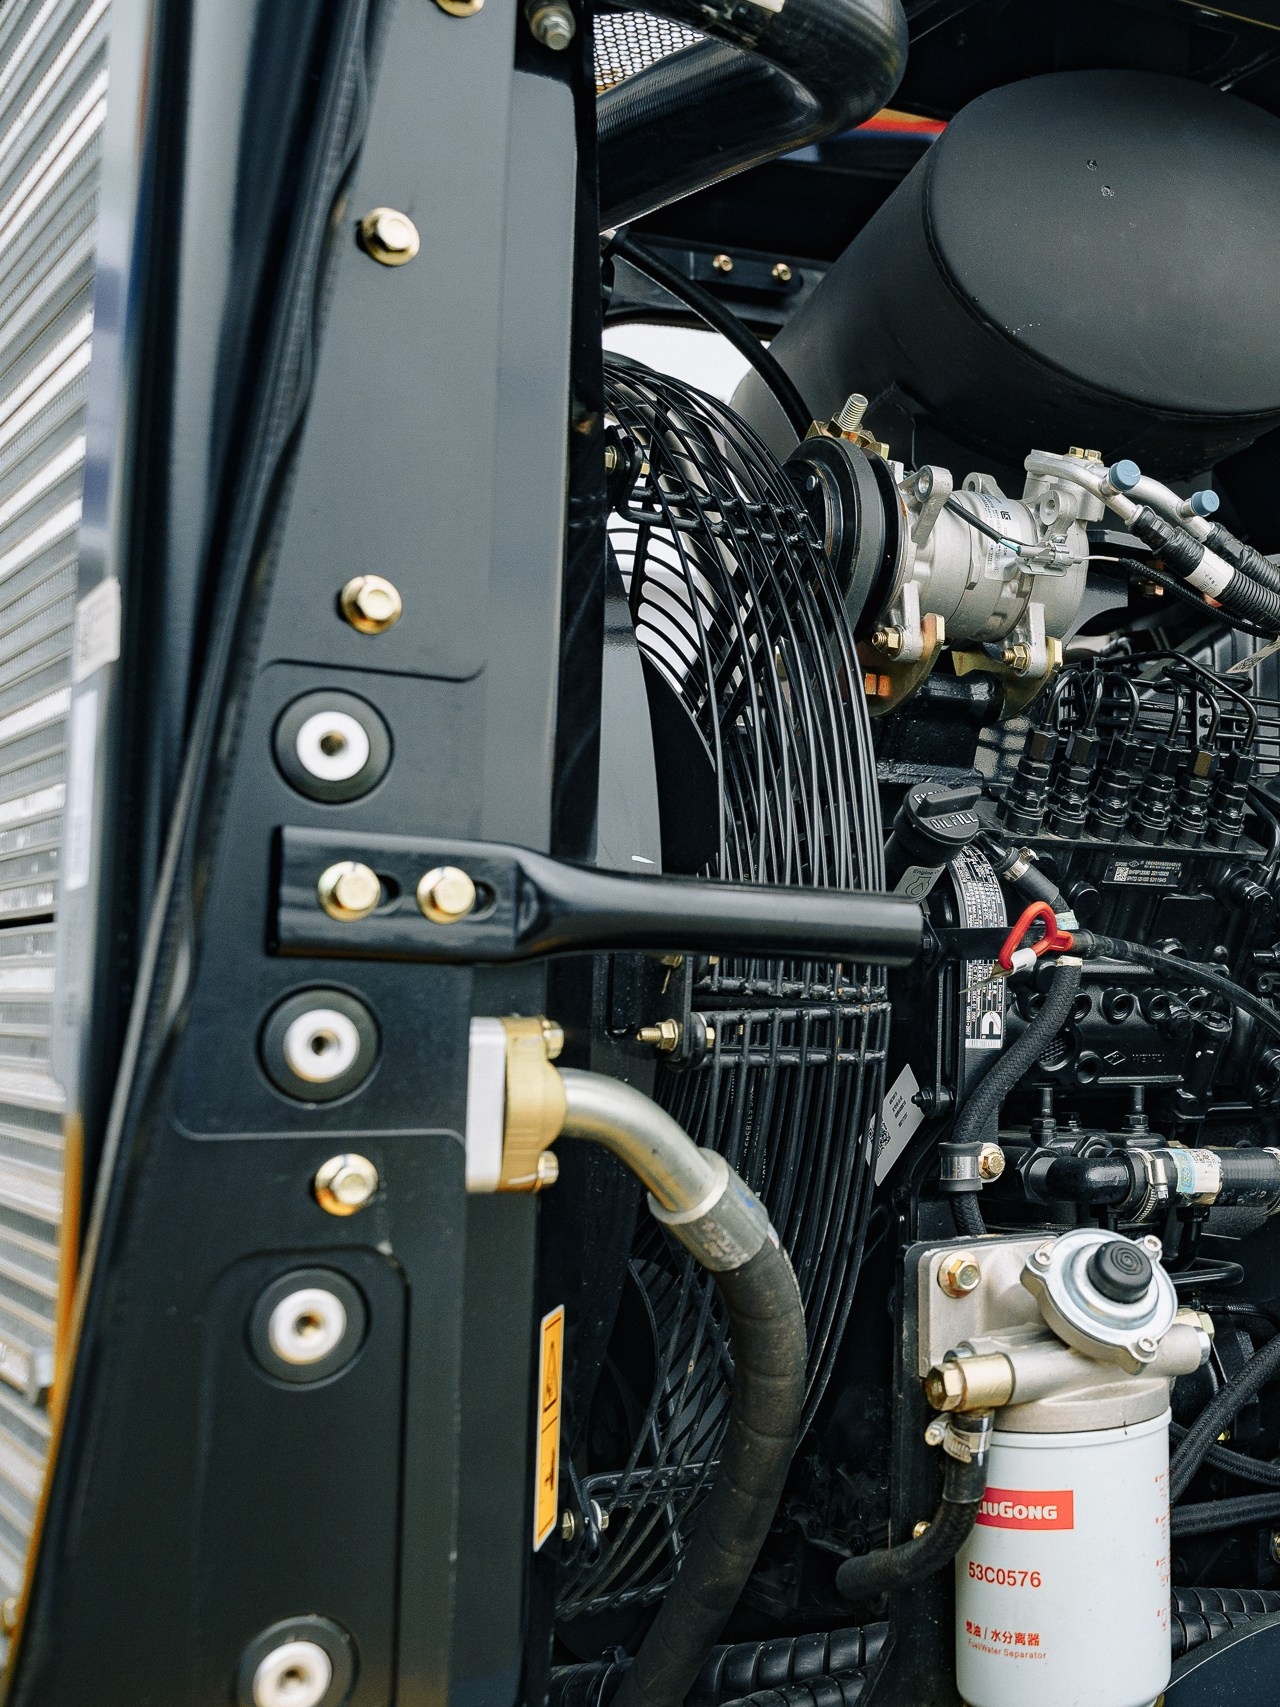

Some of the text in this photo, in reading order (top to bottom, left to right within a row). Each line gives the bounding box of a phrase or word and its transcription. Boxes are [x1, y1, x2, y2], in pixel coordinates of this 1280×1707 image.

[931, 812, 979, 830] OIL FILL
[912, 868, 934, 876] Engine
[968, 1561, 1042, 1588] 53C0576
[1003, 1648, 1047, 1660] Separator
